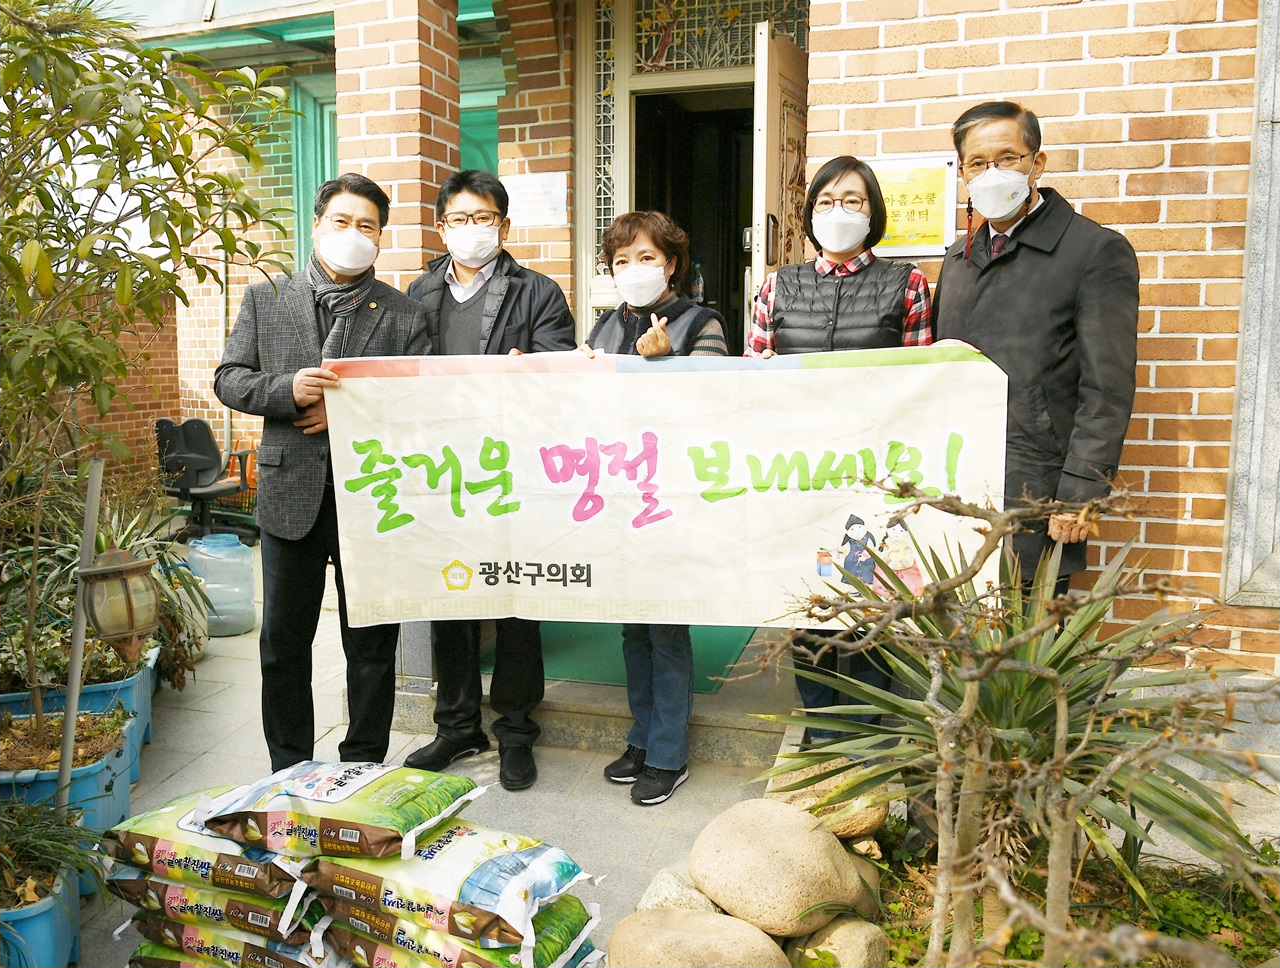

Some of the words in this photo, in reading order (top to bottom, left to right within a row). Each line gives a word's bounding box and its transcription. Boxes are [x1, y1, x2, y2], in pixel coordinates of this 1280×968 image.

[886, 209, 929, 222] 동센터
[344, 436, 521, 533] 즐거운
[539, 432, 673, 528] 명절
[478, 561, 592, 588] 광산구의회
